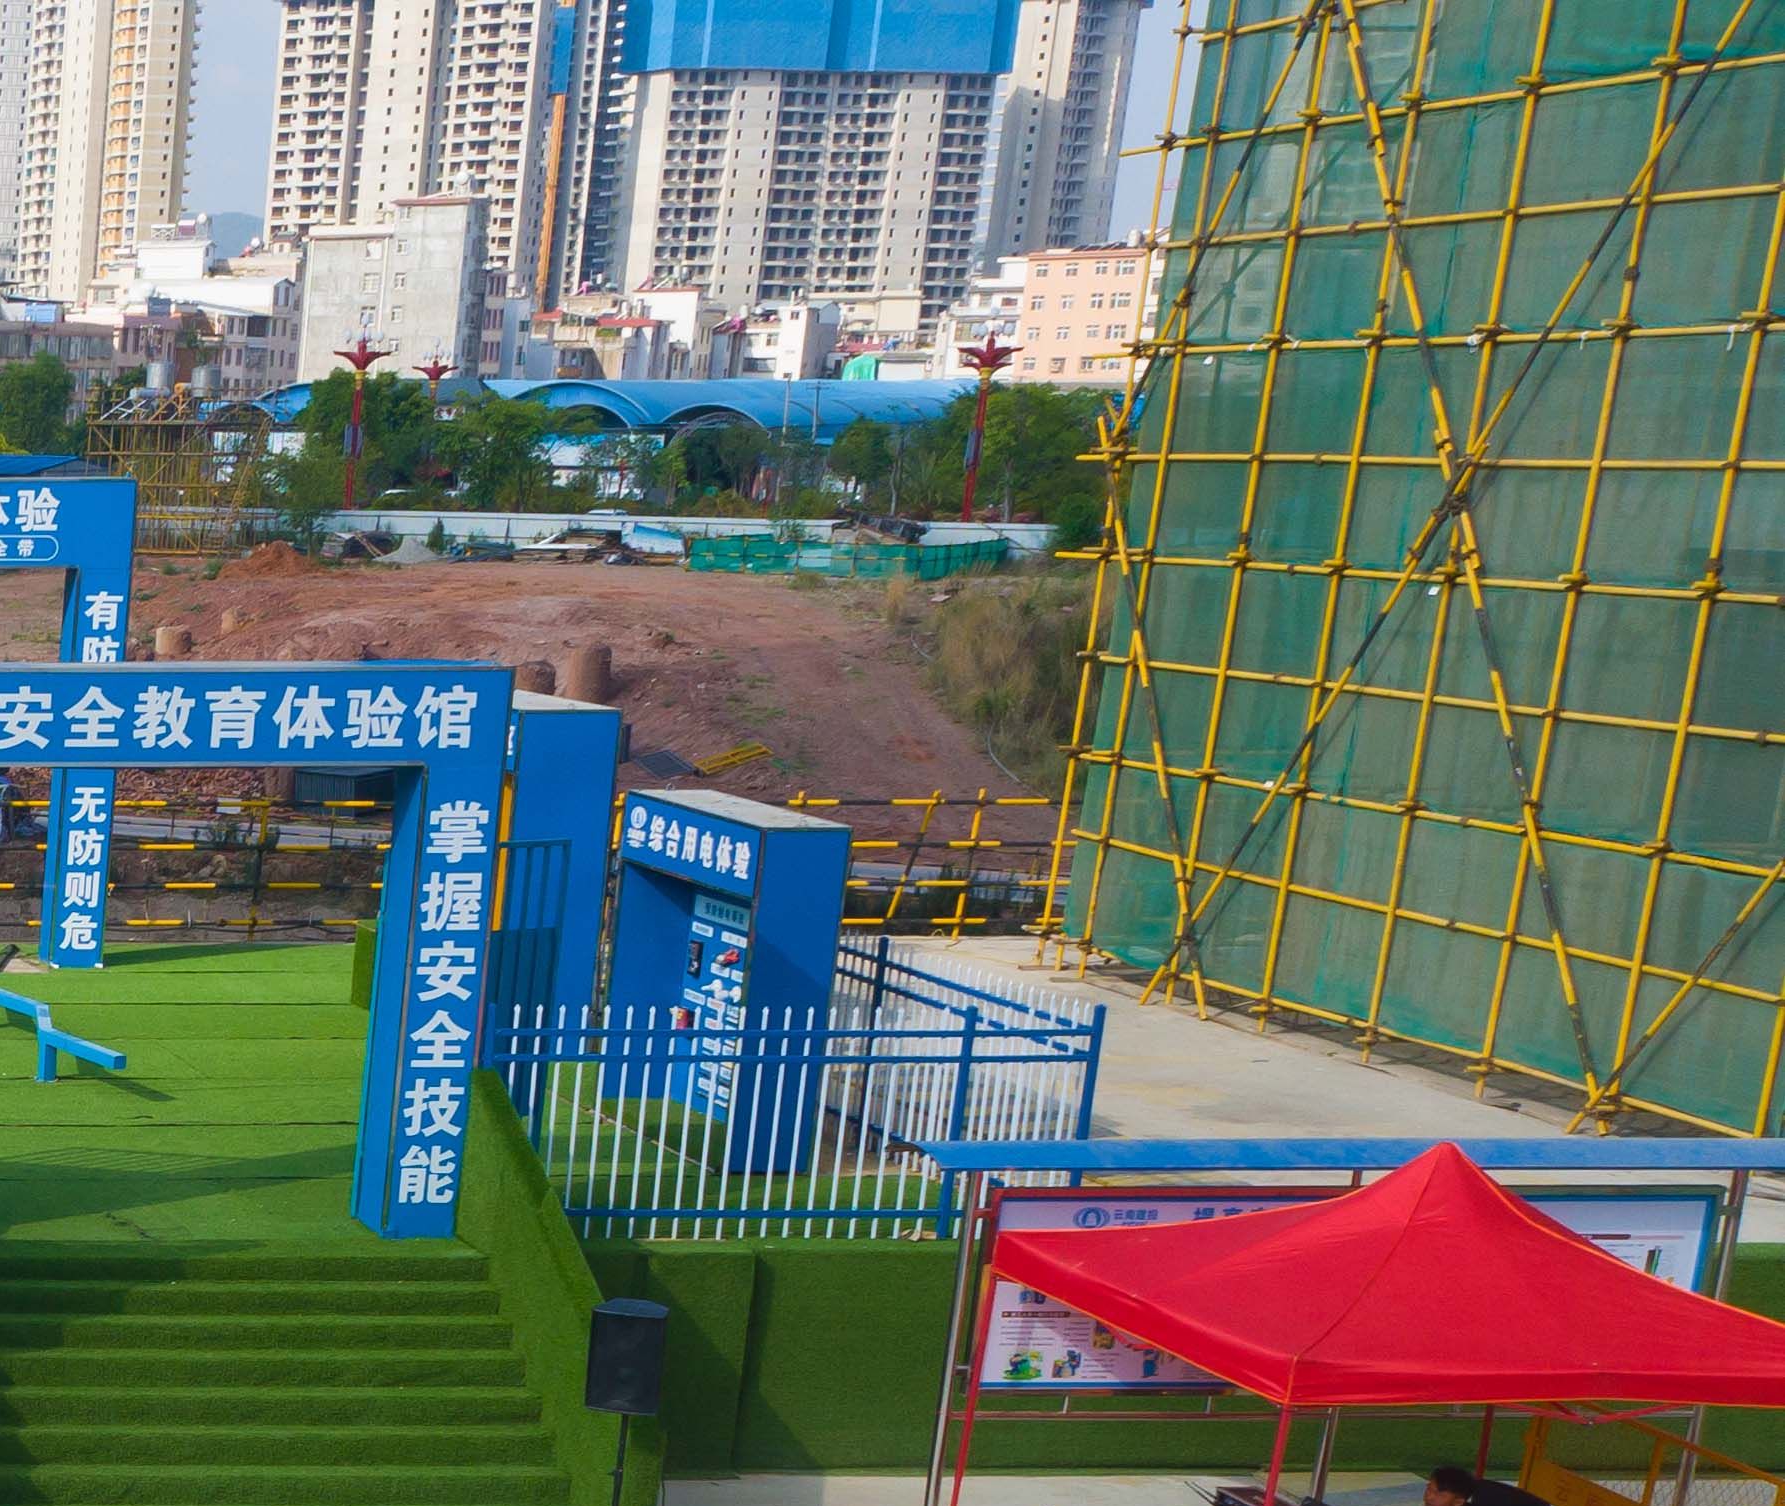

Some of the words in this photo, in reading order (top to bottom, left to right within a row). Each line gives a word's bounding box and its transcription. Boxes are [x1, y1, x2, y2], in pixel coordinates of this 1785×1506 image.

[59, 786, 106, 952] 无防则危
[648, 815, 752, 881] 综合用电体验
[397, 801, 490, 1204] 掌握安全技能
